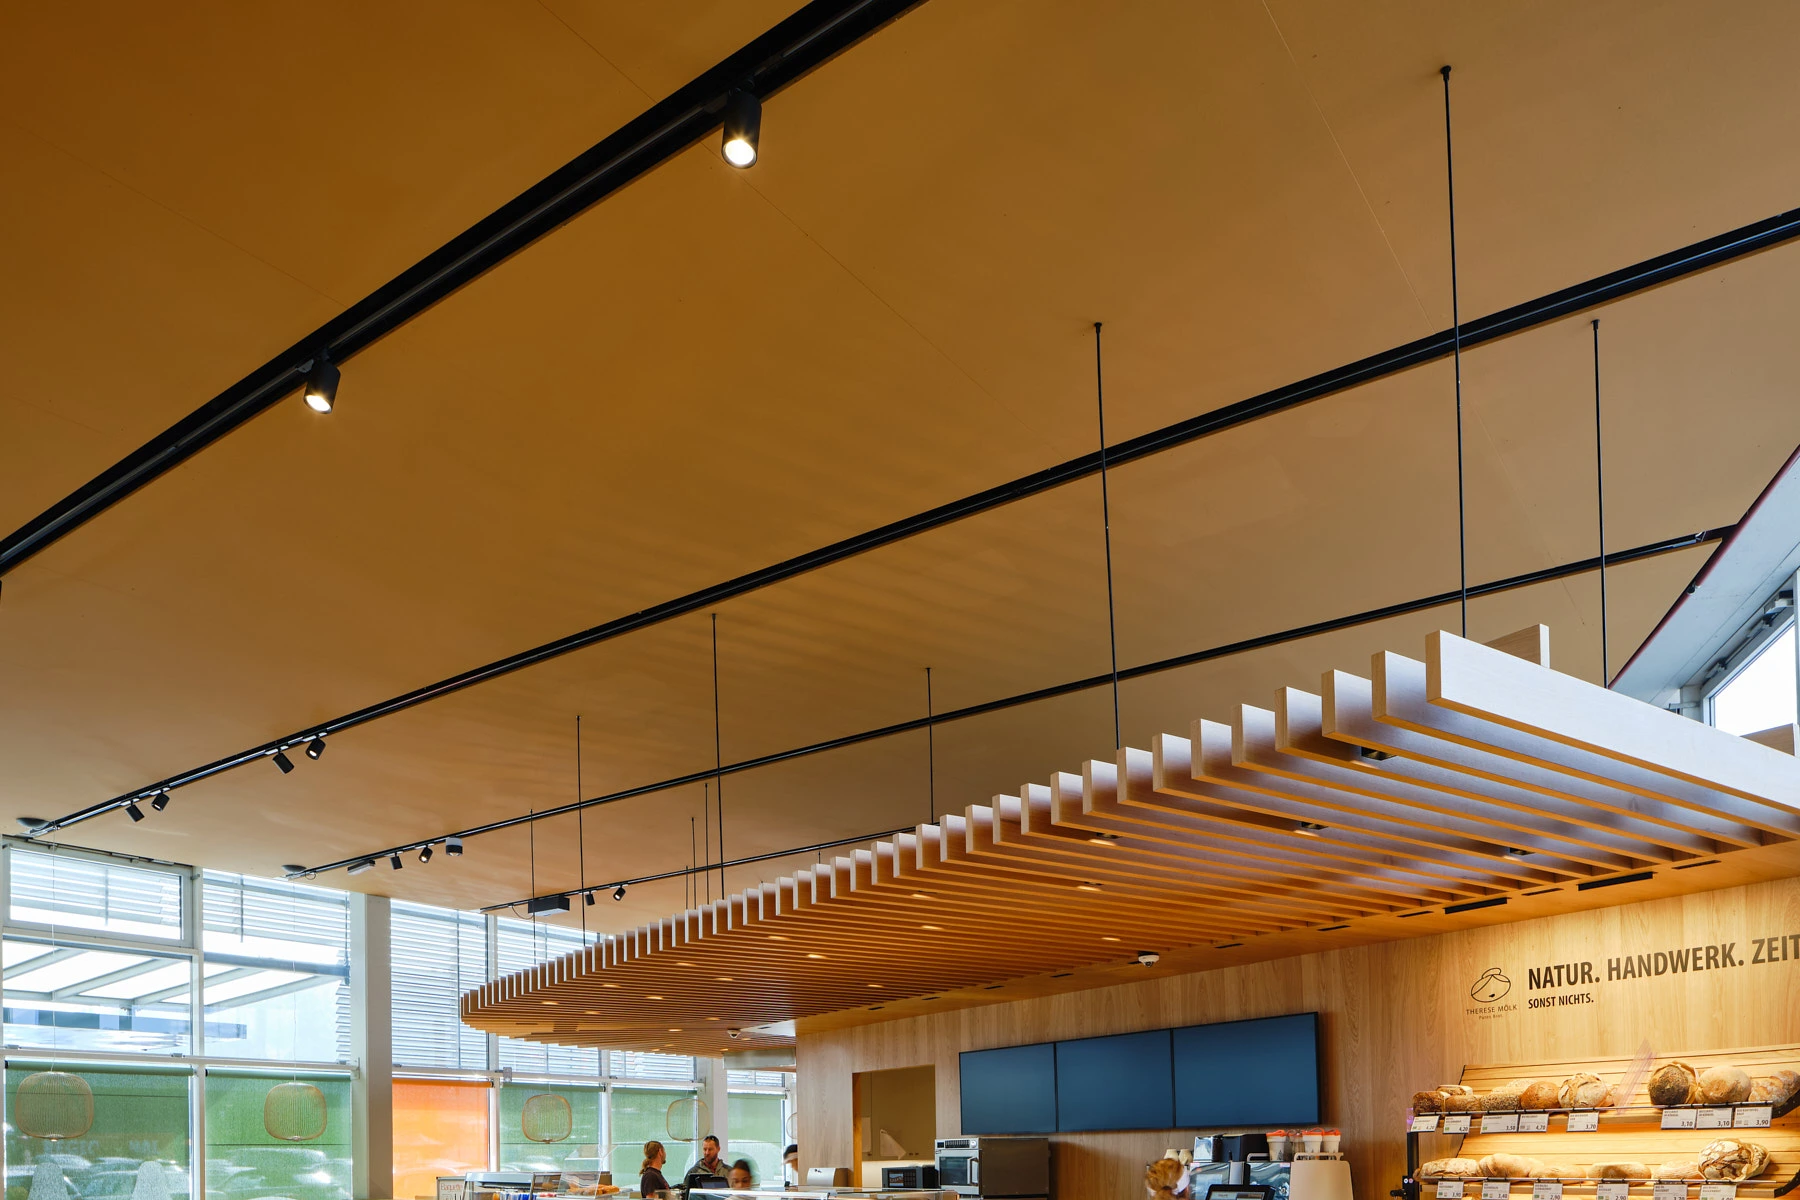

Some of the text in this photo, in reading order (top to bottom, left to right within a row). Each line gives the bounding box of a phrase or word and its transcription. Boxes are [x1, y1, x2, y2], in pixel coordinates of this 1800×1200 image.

[1528, 934, 1800, 990] NATUR. HANDWERK. ZEIT
[1528, 993, 1594, 1009] SONST NICHTS.
[1466, 1003, 1518, 1016] THERESE MÖLK
